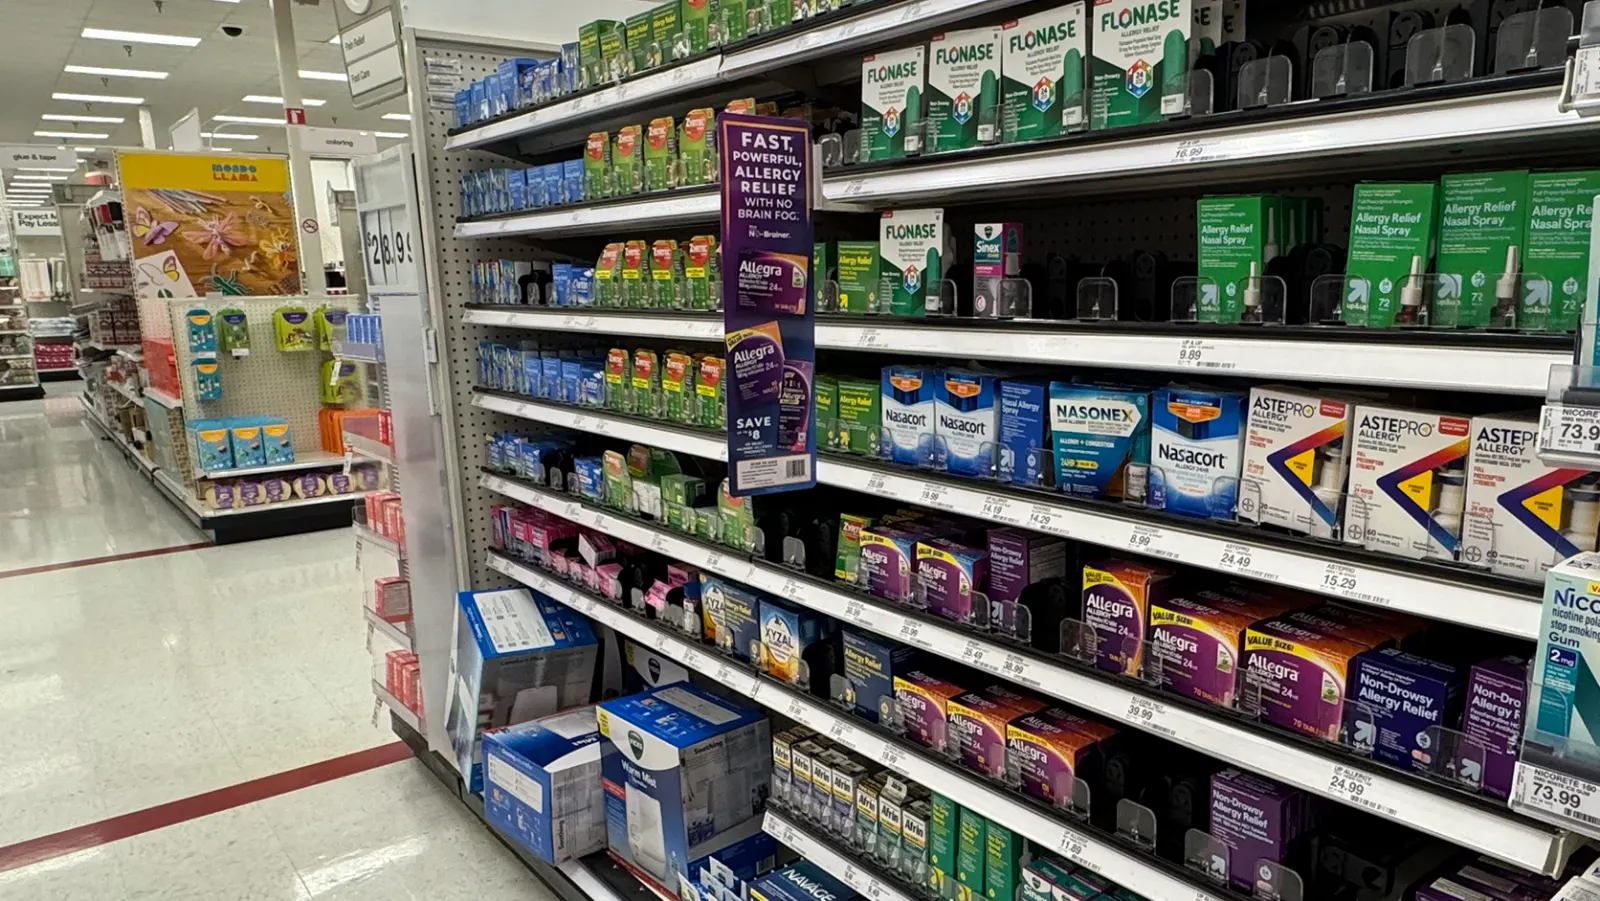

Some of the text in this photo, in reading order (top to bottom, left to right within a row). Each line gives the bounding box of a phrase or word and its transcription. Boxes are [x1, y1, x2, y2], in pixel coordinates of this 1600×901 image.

[1101, 0, 1180, 32] FLONASE
[1009, 20, 1076, 54] FLONASE
[936, 44, 994, 65] FLONASE
[867, 61, 917, 85] FLONASE
[326, 139, 354, 147] coloring
[741, 132, 793, 153] FAST,
[733, 151, 802, 167] POWERFUL,
[1176, 148, 1202, 158] 16.99
[213, 173, 258, 182] LLAMA
[735, 166, 801, 181] ALLERGY
[741, 181, 796, 195] RELIEF
[745, 197, 792, 208] WITH NO
[1444, 201, 1516, 214] Allergy Relief
[738, 209, 800, 221] BRAIN FOG.
[1356, 213, 1421, 225] Allergy Relief
[1532, 206, 1574, 217] Allergy
[19, 220, 35, 228] Pay
[1443, 215, 1505, 227] Nasal Spray
[1530, 218, 1592, 230] Nasal Spra
[886, 223, 936, 239] FLONASE
[1202, 224, 1253, 236] Allergy Relief
[1355, 226, 1411, 236] Nasal Spray
[976, 241, 1000, 254] Sinex
[1201, 236, 1246, 246] Nasal Spray
[839, 256, 873, 266] Allergy Relief
[739, 261, 782, 277] Allegra
[1378, 298, 1390, 308] 72
[1472, 293, 1483, 301] 72
[1563, 300, 1576, 310] 72
[734, 344, 775, 363] Allegra
[1180, 350, 1201, 361] 9.89
[840, 396, 872, 406] Allergy Relief
[1002, 398, 1039, 412] Nasal Allergy
[1253, 396, 1315, 418] ASTEPRO
[886, 409, 927, 426] Nasacort
[1002, 406, 1019, 416] Spray
[1057, 405, 1134, 423] NASONEX
[1252, 410, 1288, 422] ALLERGY
[1563, 408, 1600, 418] NICORE
[736, 417, 771, 429] SAVE
[940, 415, 986, 435] Nasacort
[1360, 415, 1435, 437] ASTEPRO
[1359, 429, 1401, 442] ALLERGY
[1477, 427, 1538, 448] ASTEP
[1561, 423, 1600, 440] 73.9
[1085, 440, 1114, 448] CONGESTION
[1476, 442, 1526, 455] ALLERGY
[1159, 444, 1226, 469] Nasacort
[1473, 473, 1505, 482] PRESCRIPTION
[921, 490, 940, 501] 19.99
[983, 503, 1002, 514] 14.19
[1029, 513, 1051, 524] 14.29
[1367, 528, 1376, 536] 60
[1130, 535, 1150, 546] 8.99
[862, 548, 888, 565] Allegra
[990, 552, 1024, 566] Allergy Relief
[1221, 552, 1251, 567] 24.49
[918, 560, 948, 580] Allegra
[1326, 563, 1355, 574] ASTEPRO
[1323, 574, 1357, 590] 15.29
[1087, 593, 1134, 618] Allegra
[1554, 588, 1600, 614] NICO
[1153, 612, 1193, 626] VALUE SIZE!
[1552, 608, 1600, 627] nicotine pola
[901, 626, 918, 637] 20.99
[1551, 620, 1567, 632] stop
[765, 627, 794, 647] XYZAL
[1154, 628, 1198, 654] Allegra
[1248, 636, 1294, 651] VALUE SIZE!
[1549, 632, 1580, 648] Gum
[964, 647, 983, 660] 35.49
[1550, 650, 1574, 667] 2 mg
[863, 657, 881, 670] Relief
[1003, 659, 1024, 674] 38.99
[1248, 653, 1299, 682] Allegra
[1360, 673, 1434, 708] Non-Drowsy
[1473, 683, 1521, 707] Non-Dro
[896, 690, 926, 712] Allegra
[1359, 687, 1438, 721] Allergy Relief
[1472, 696, 1512, 717] Allergy
[1128, 706, 1153, 720] 39.99
[950, 712, 983, 735] Allegra
[775, 746, 789, 759] Afrin
[1010, 737, 1048, 764] Allegra
[795, 755, 809, 770] Afrin
[621, 758, 657, 788] Warm Mist
[814, 766, 830, 782] Afrin
[1344, 768, 1372, 782] ALLERGY
[1535, 768, 1597, 793] NICORETE 160
[835, 777, 851, 792] Afrin
[1329, 776, 1365, 796] 24.99
[1533, 782, 1581, 809] 73.99
[859, 795, 876, 812] Afrin
[1212, 790, 1264, 817] Non-Drowsy
[882, 807, 899, 824] Afrin
[1212, 801, 1242, 820] Allergy
[1243, 812, 1268, 829] Relief
[905, 819, 924, 838] Afrin
[1060, 838, 1082, 855] 11.89
